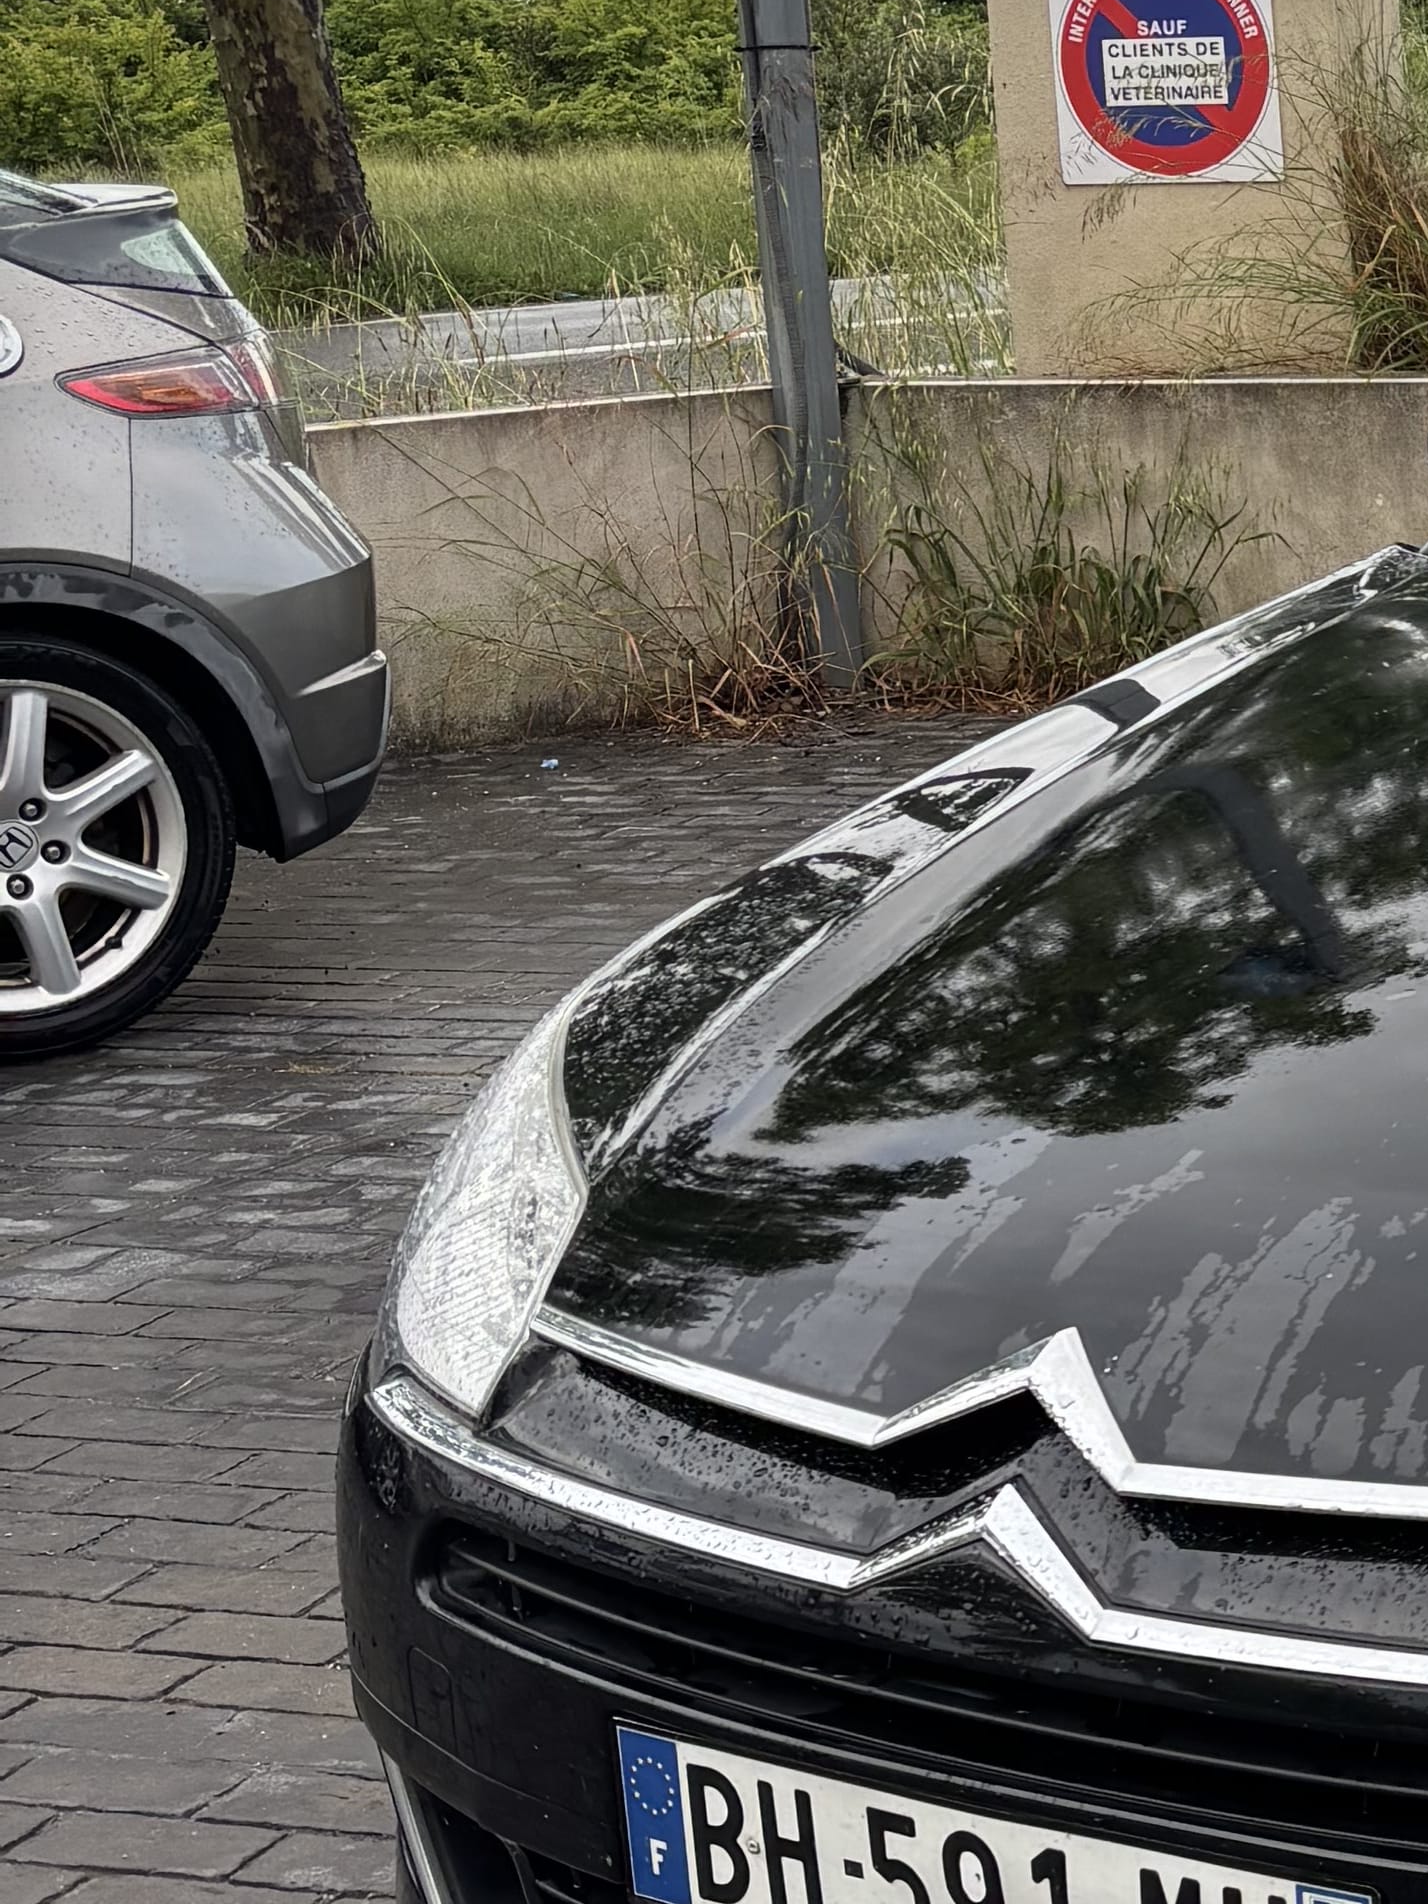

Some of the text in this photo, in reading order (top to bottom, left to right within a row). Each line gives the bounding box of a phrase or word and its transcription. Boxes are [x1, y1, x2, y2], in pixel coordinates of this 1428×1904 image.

[1137, 19, 1187, 36] SAUF
[1108, 41, 1220, 58] CLIENTS DE
[1112, 63, 1220, 80] LA CLINIQUE
[1111, 84, 1224, 101] VETERINAIRE
[648, 1837, 668, 1876] F
